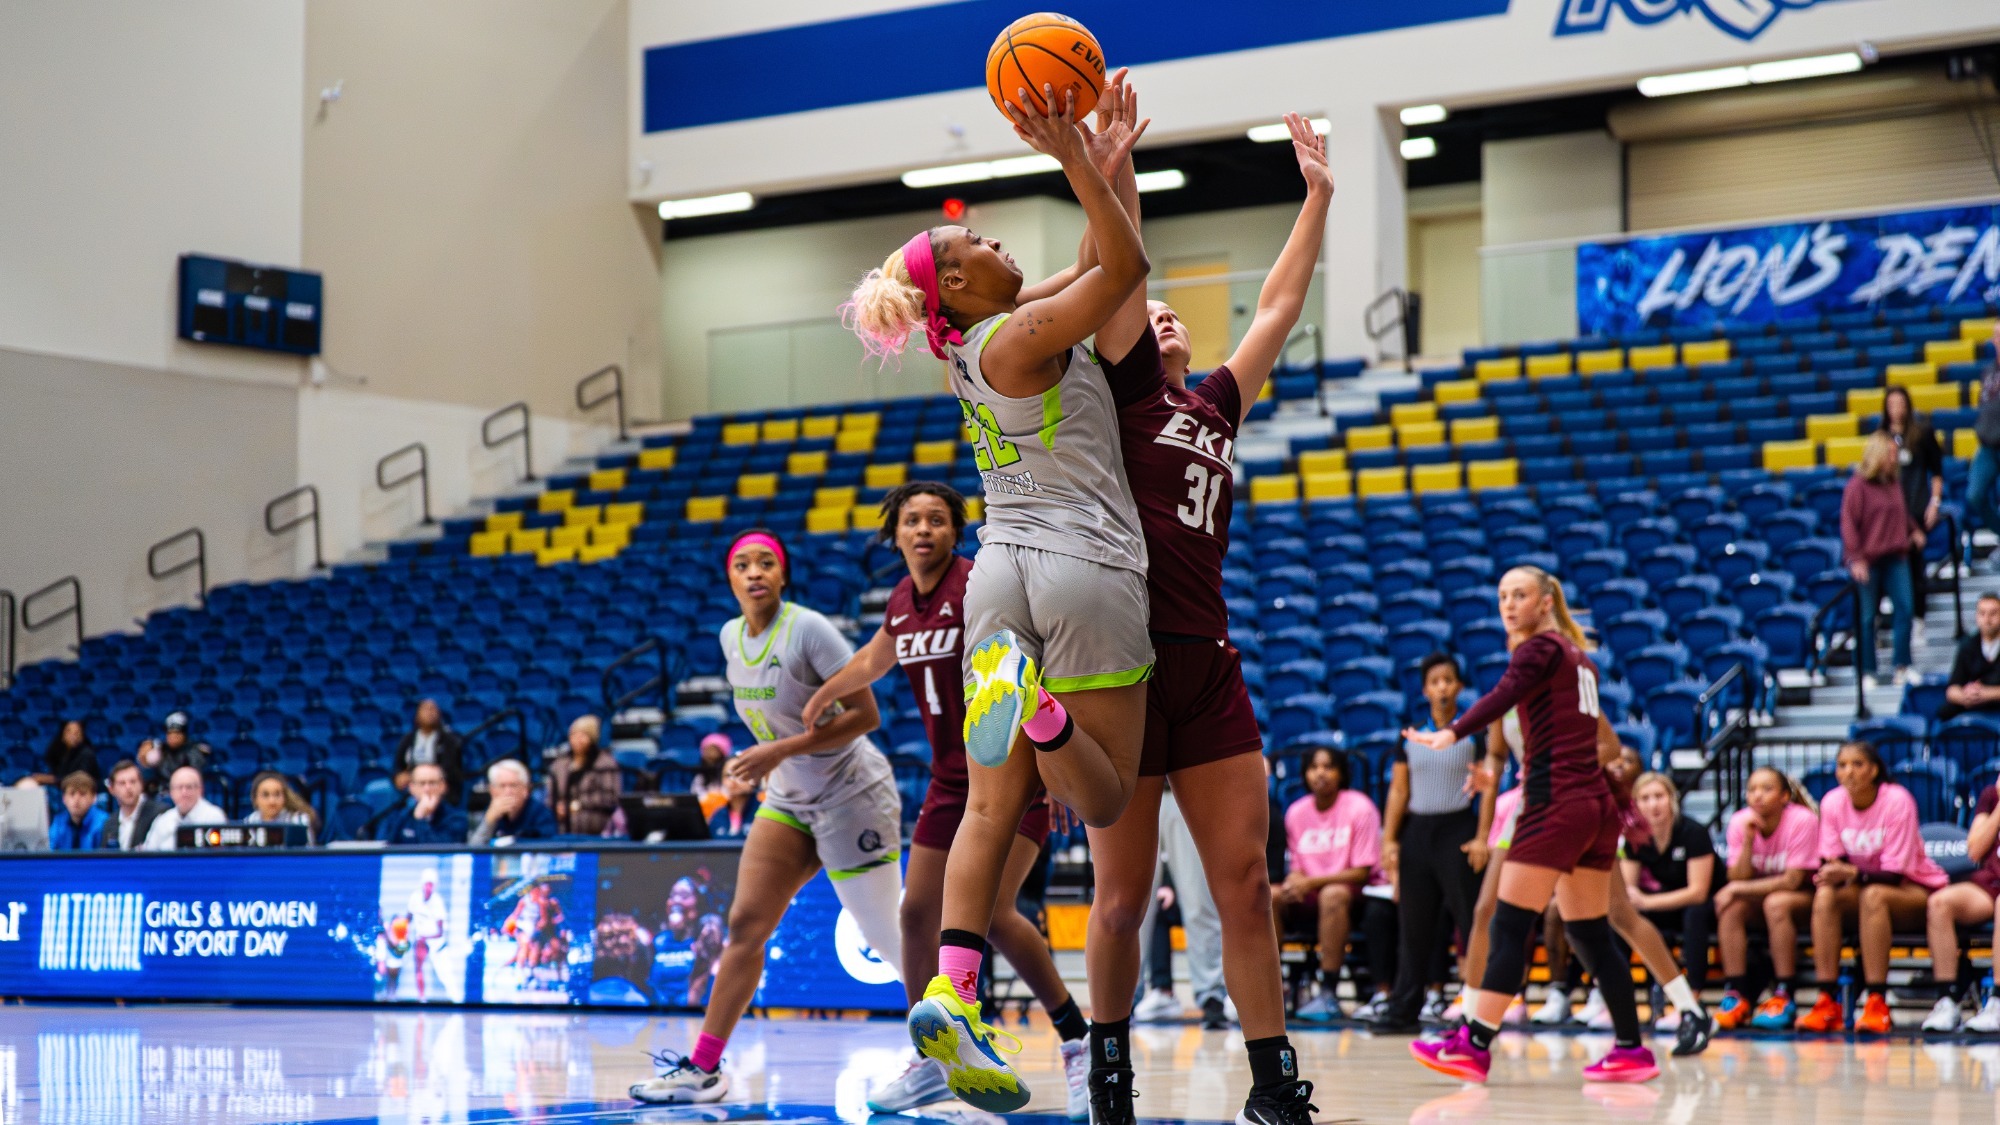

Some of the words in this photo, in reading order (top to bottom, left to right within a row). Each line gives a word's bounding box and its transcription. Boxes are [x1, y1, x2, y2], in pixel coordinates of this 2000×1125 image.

[1637, 221, 1847, 325] LION'S
[1177, 462, 1225, 536] 31
[895, 627, 960, 659] EKU
[1577, 664, 1600, 719] 10
[1923, 839, 1968, 857] EENS
[38, 892, 144, 972] NATIONAL
[144, 900, 204, 928] GIRLS
[207, 900, 225, 928] &
[227, 900, 318, 928] WOMEN
[143, 930, 169, 957] IN
[172, 929, 240, 957] SPORT
[243, 930, 289, 958] DAY
